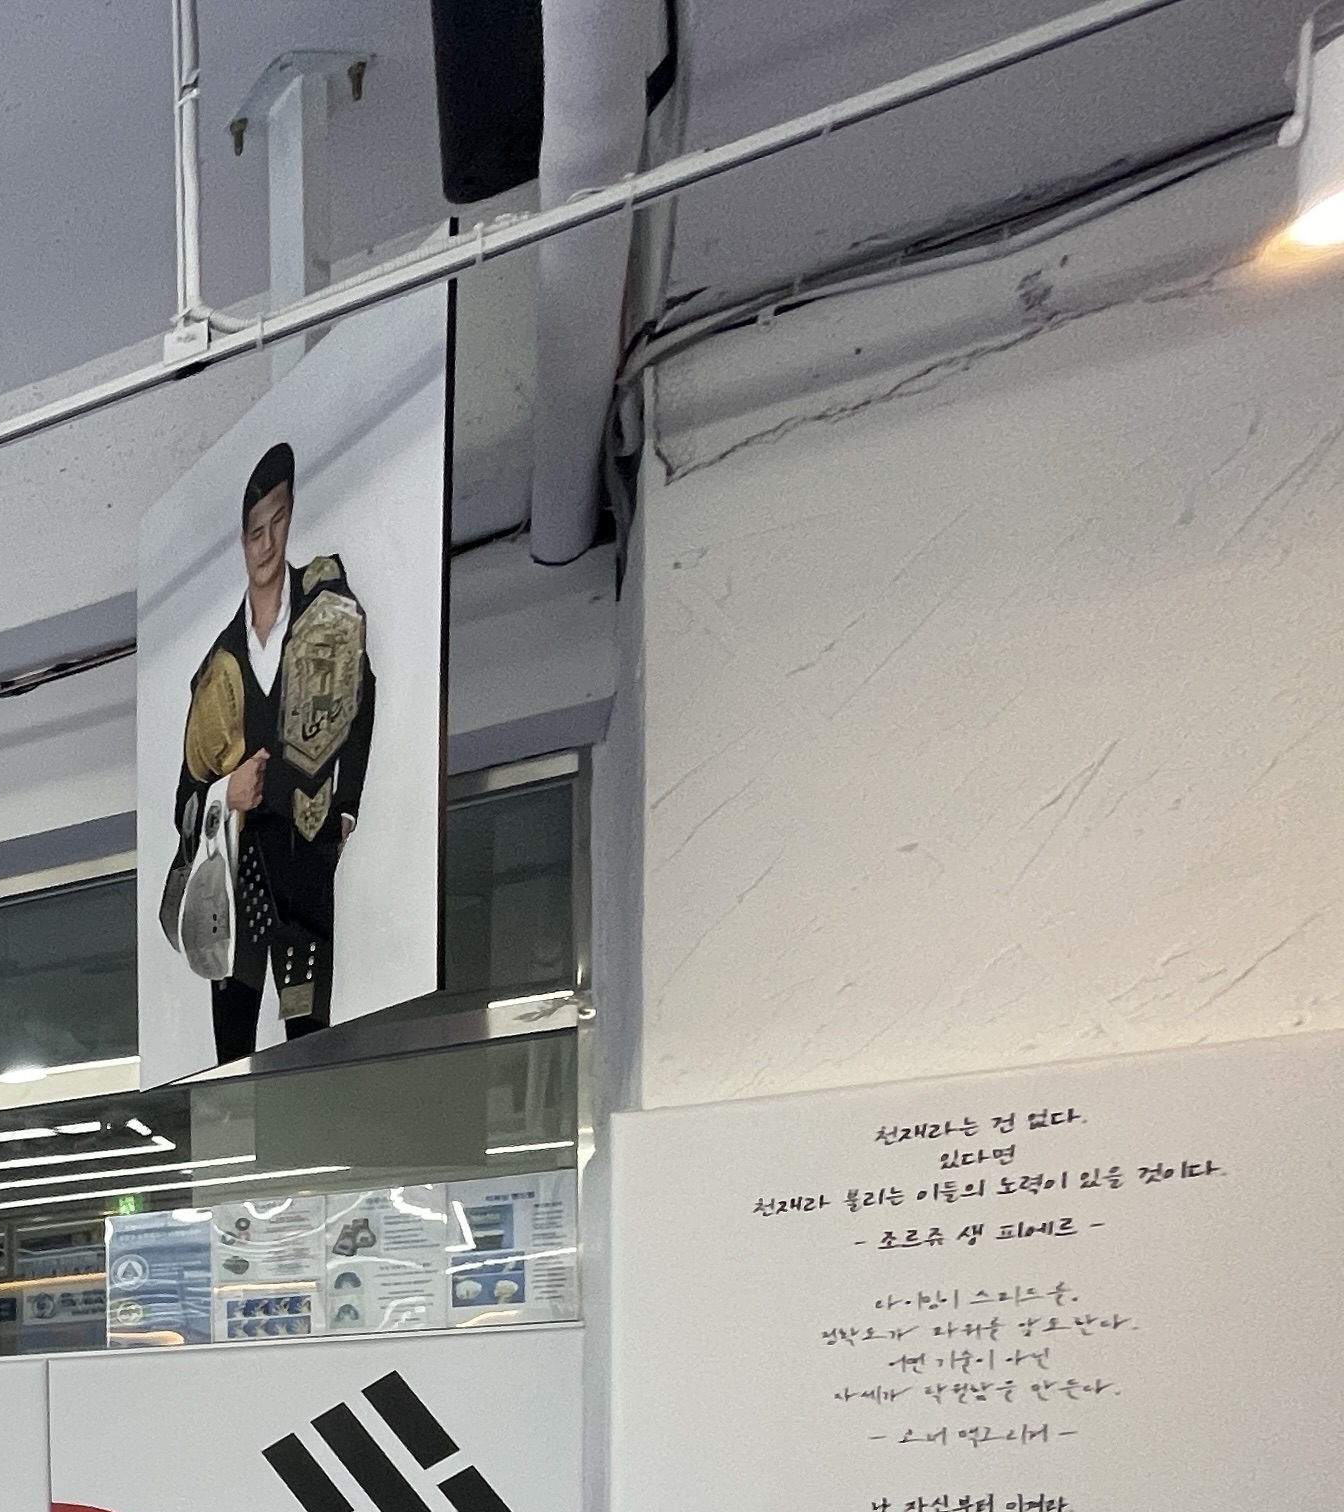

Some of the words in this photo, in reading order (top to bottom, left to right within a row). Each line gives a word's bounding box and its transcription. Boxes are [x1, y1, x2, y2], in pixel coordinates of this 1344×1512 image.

[873, 1116, 979, 1147] 천재라는
[990, 1112, 1016, 1135] 건
[939, 1143, 1017, 1171] 있다면
[752, 1193, 832, 1218] 천재라
[842, 1186, 905, 1214] 불리는
[916, 1178, 986, 1204] 이들의
[995, 1170, 1069, 1196] 노력이
[1079, 1165, 1124, 1190] 있을
[955, 1223, 985, 1247] 생
[995, 1217, 1079, 1241] 피에르
[936, 1348, 995, 1375] 기술이
[1004, 1346, 1050, 1370] 아닌
[833, 1384, 913, 1405] 자세가
